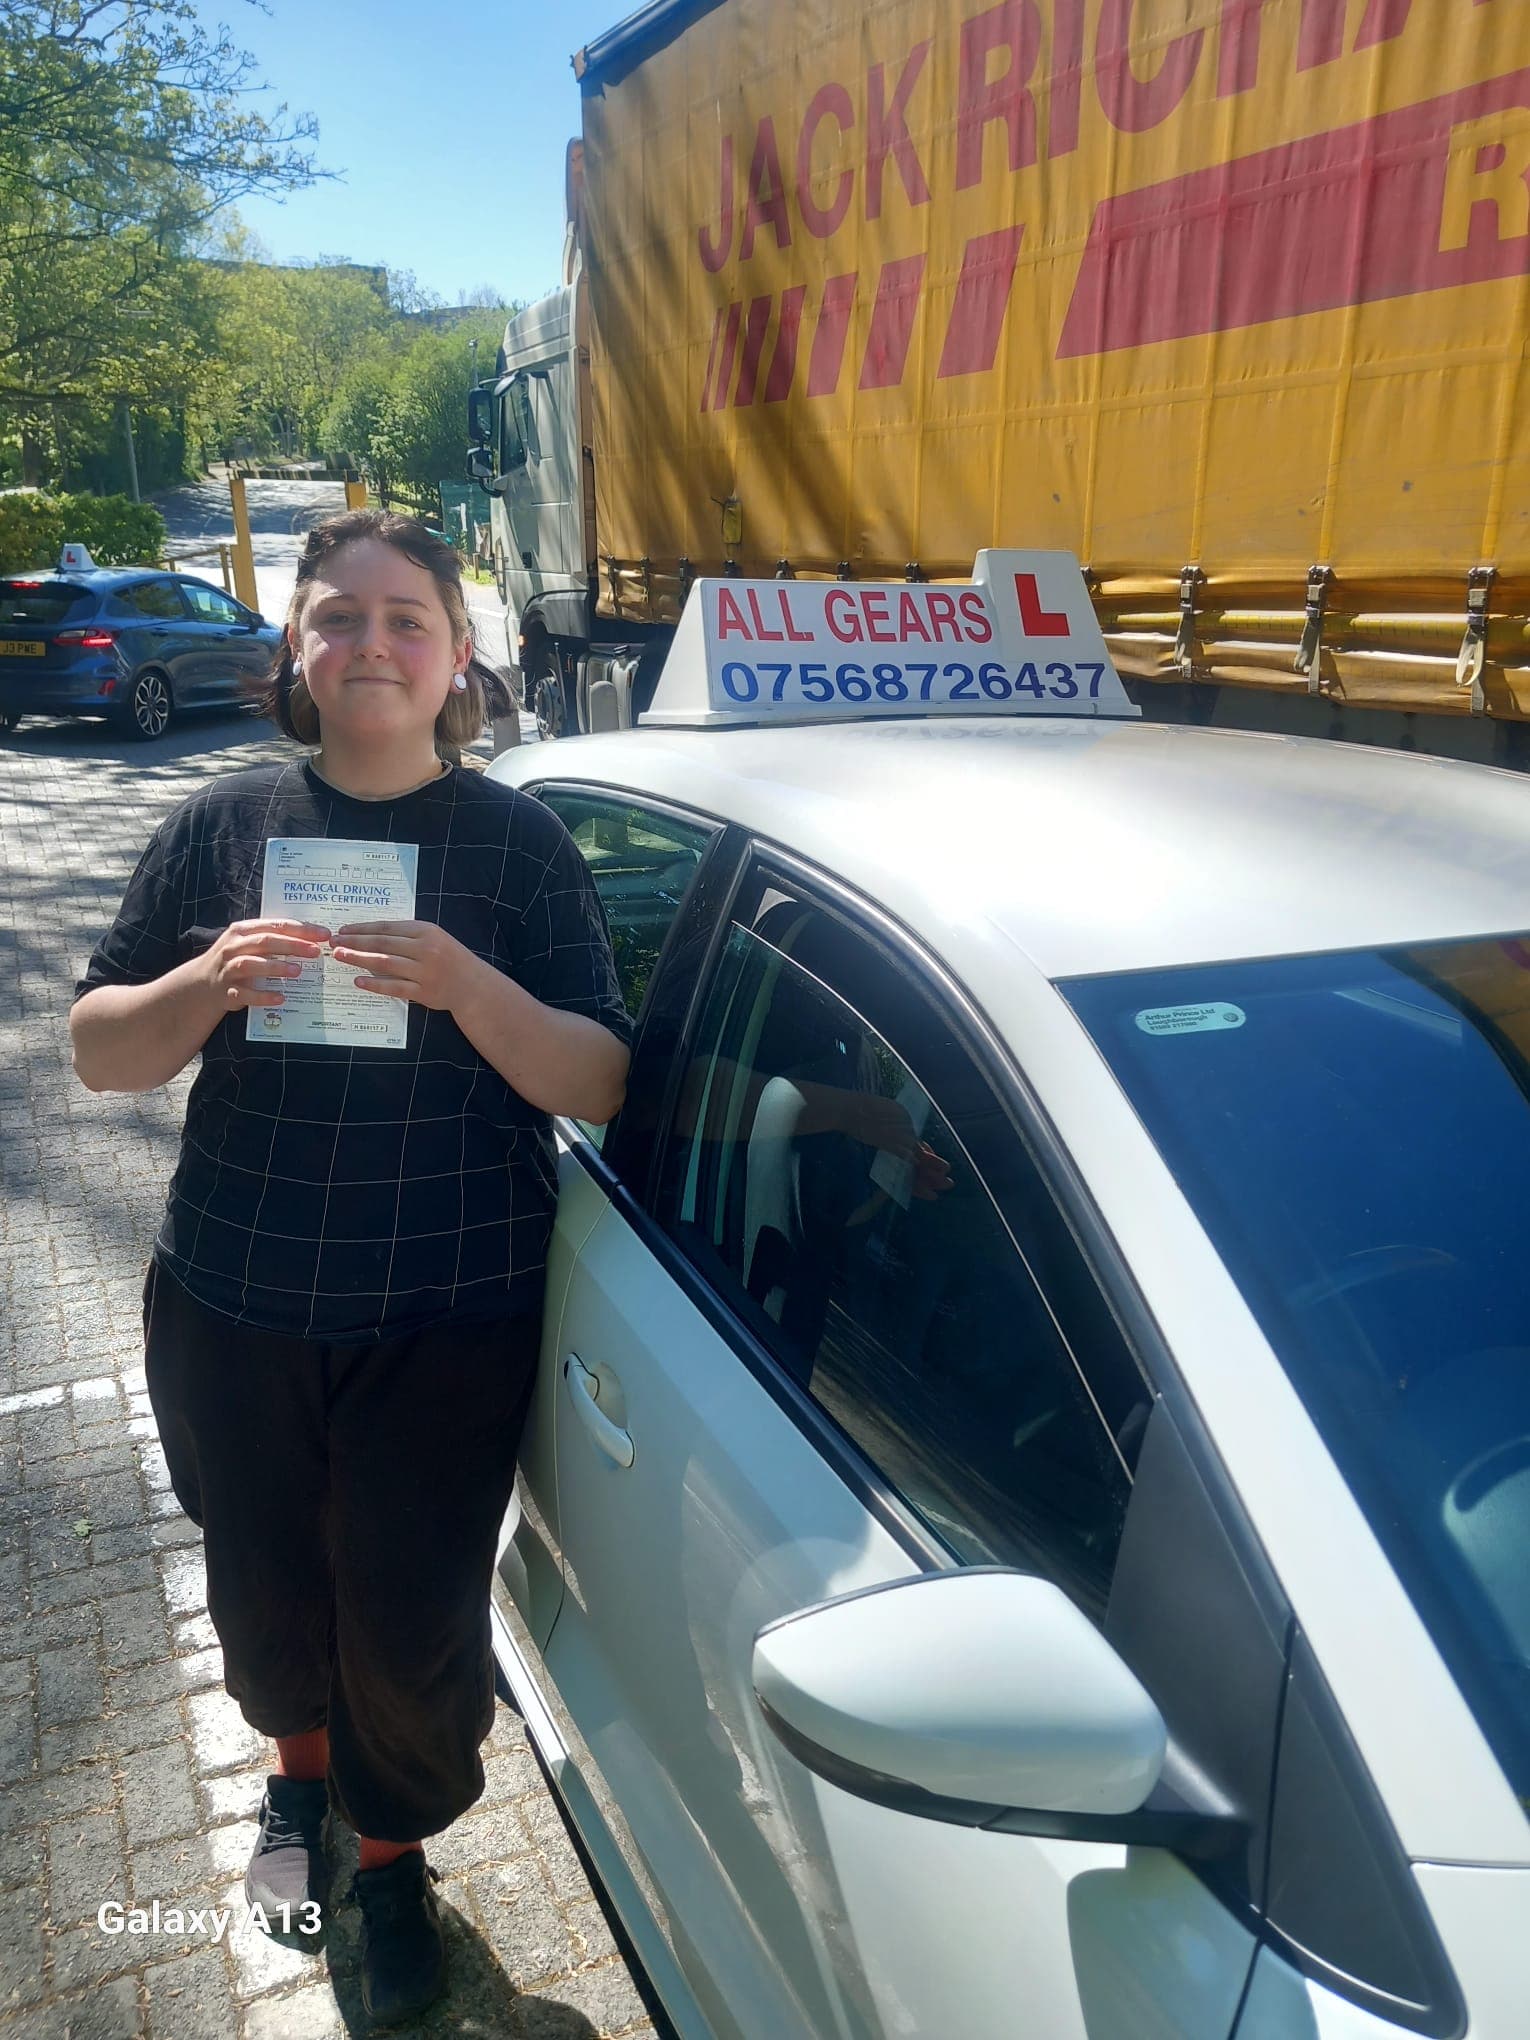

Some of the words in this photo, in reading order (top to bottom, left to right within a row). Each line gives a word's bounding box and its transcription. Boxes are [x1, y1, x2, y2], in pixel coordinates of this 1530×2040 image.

[698, 38, 934, 274] JACK
[67, 551, 76, 562] L
[717, 587, 816, 642] ALL
[824, 589, 993, 644] GEARS
[1013, 573, 1071, 637] L
[721, 662, 1106, 702] 07568726437
[284, 882, 340, 893] PRACTICAL
[343, 884, 391, 896] DRIVING
[284, 893, 304, 901] TEST
[306, 893, 328, 902] PASS
[331, 894, 391, 906] CERTIFICATE
